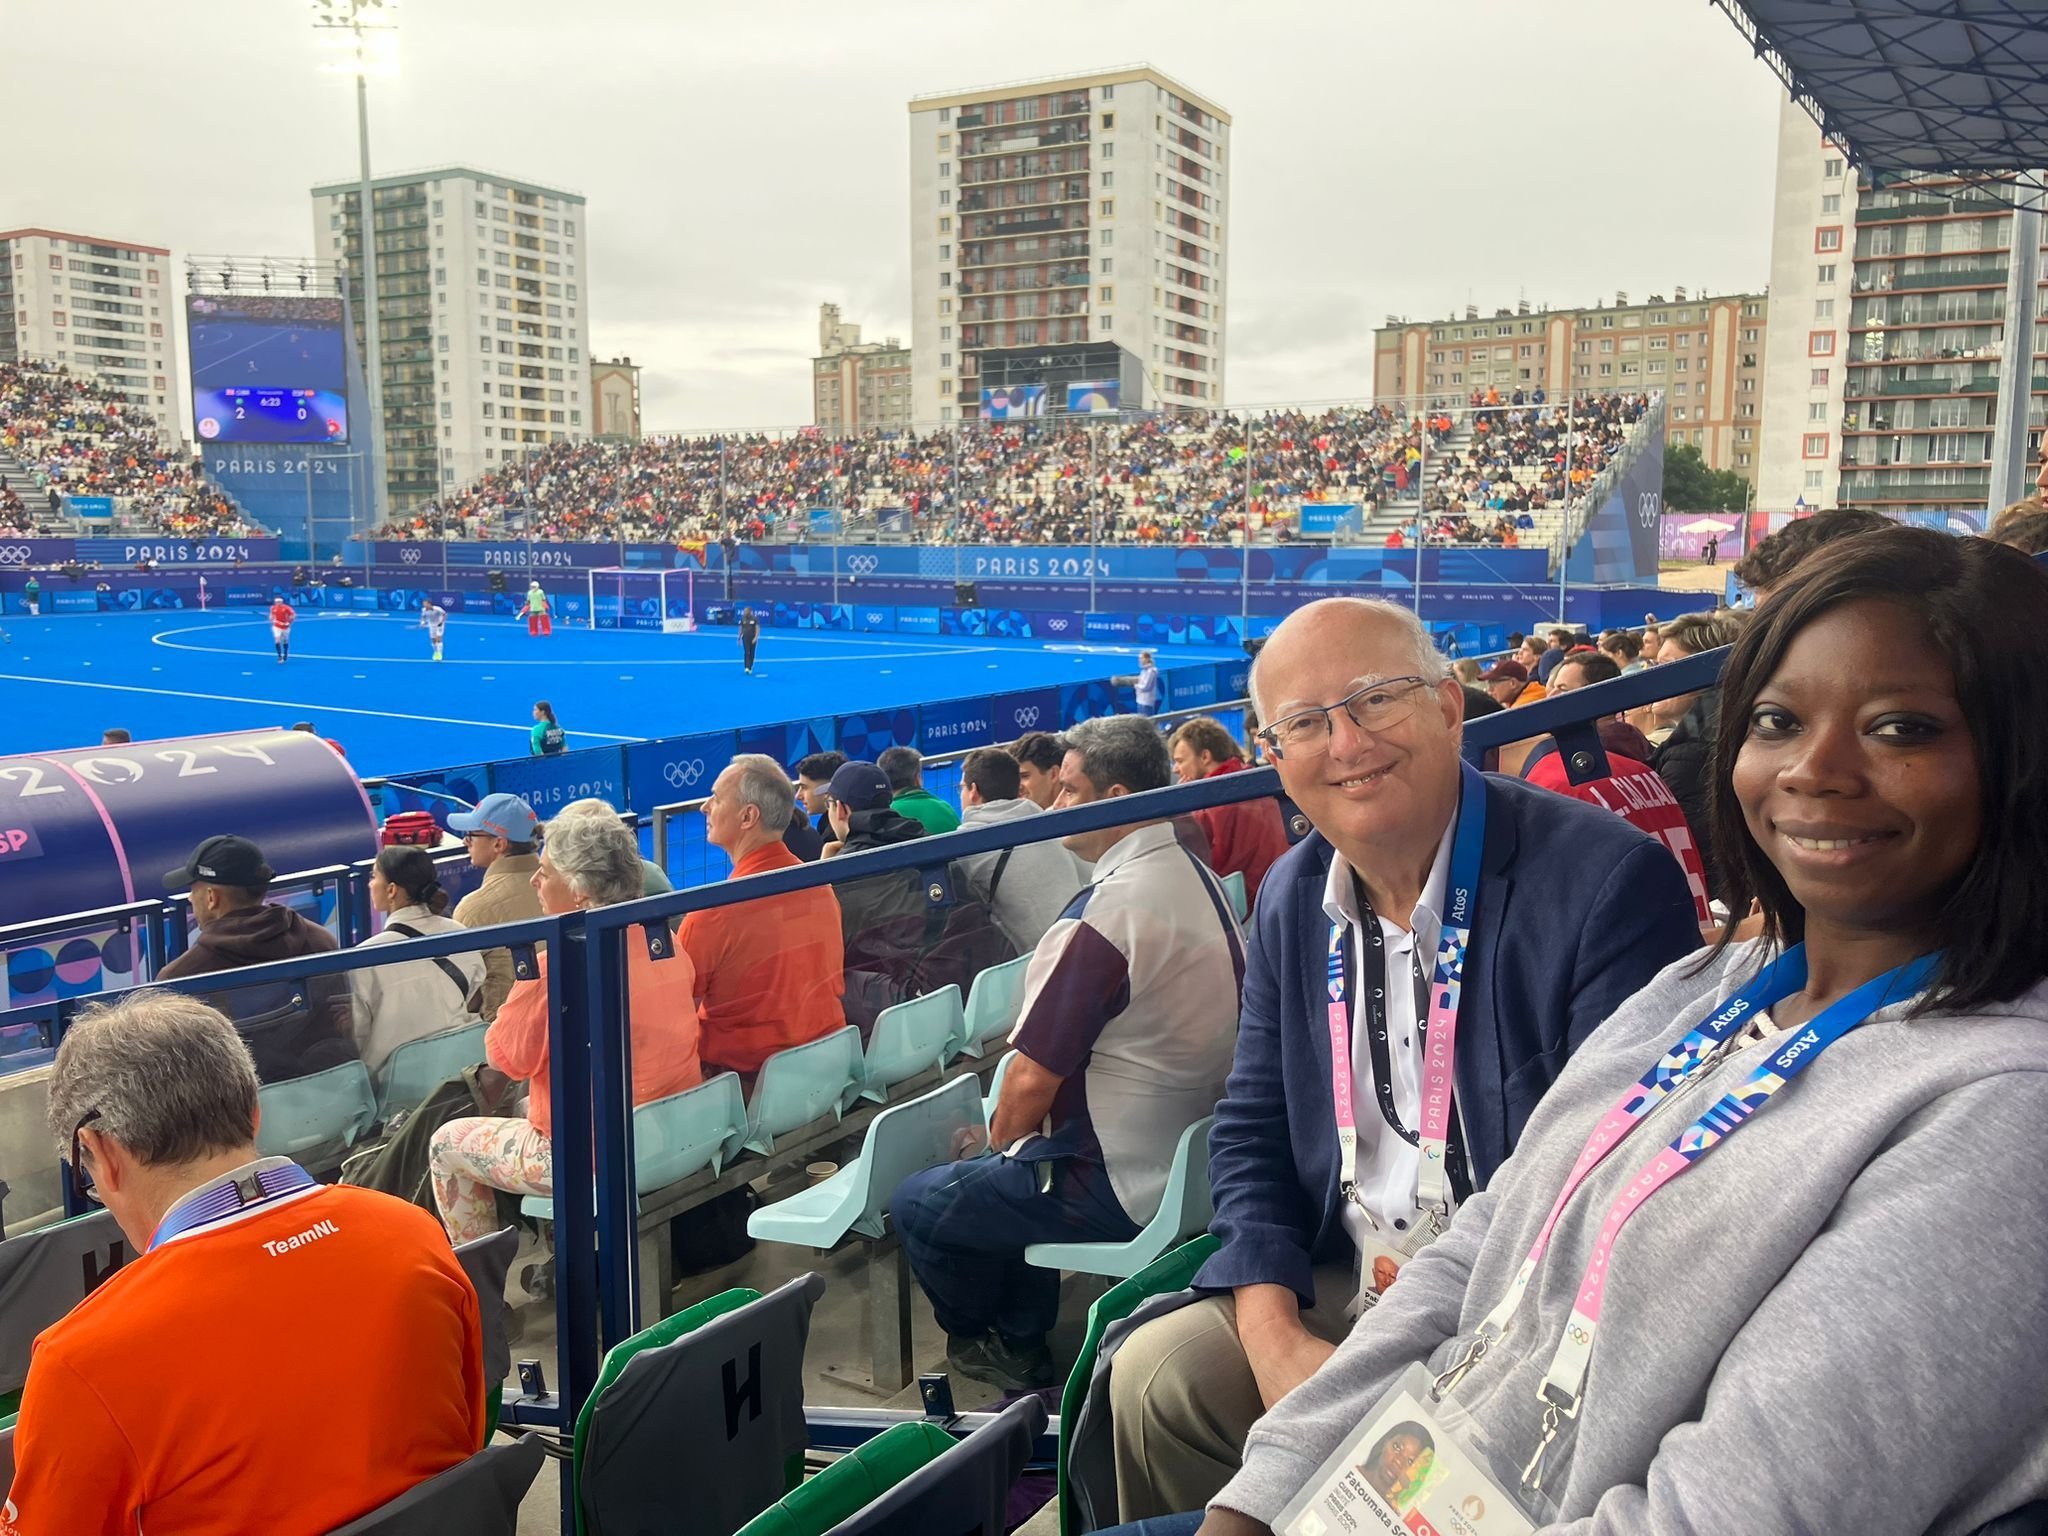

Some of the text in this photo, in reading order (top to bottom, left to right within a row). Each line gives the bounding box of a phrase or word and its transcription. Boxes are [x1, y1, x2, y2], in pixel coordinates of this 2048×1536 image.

[235, 407, 245, 419] 2
[297, 408, 307, 420] 0
[216, 459, 337, 474] PARIS 2024
[125, 544, 249, 561] PARIS 2024
[484, 551, 572, 566] PARIS 2024
[976, 558, 1110, 576] PARIS 2024
[928, 719, 987, 739] PARIS 2024
[0, 744, 276, 797] 2024
[520, 780, 612, 806] ARIS 2024
[1427, 1019, 1447, 1131] PARIS 2024
[1337, 1071, 1349, 1119] 2024
[262, 1219, 340, 1257] TeamNL
[722, 1342, 762, 1442] H
[1345, 1471, 1392, 1528] Fatoumata
